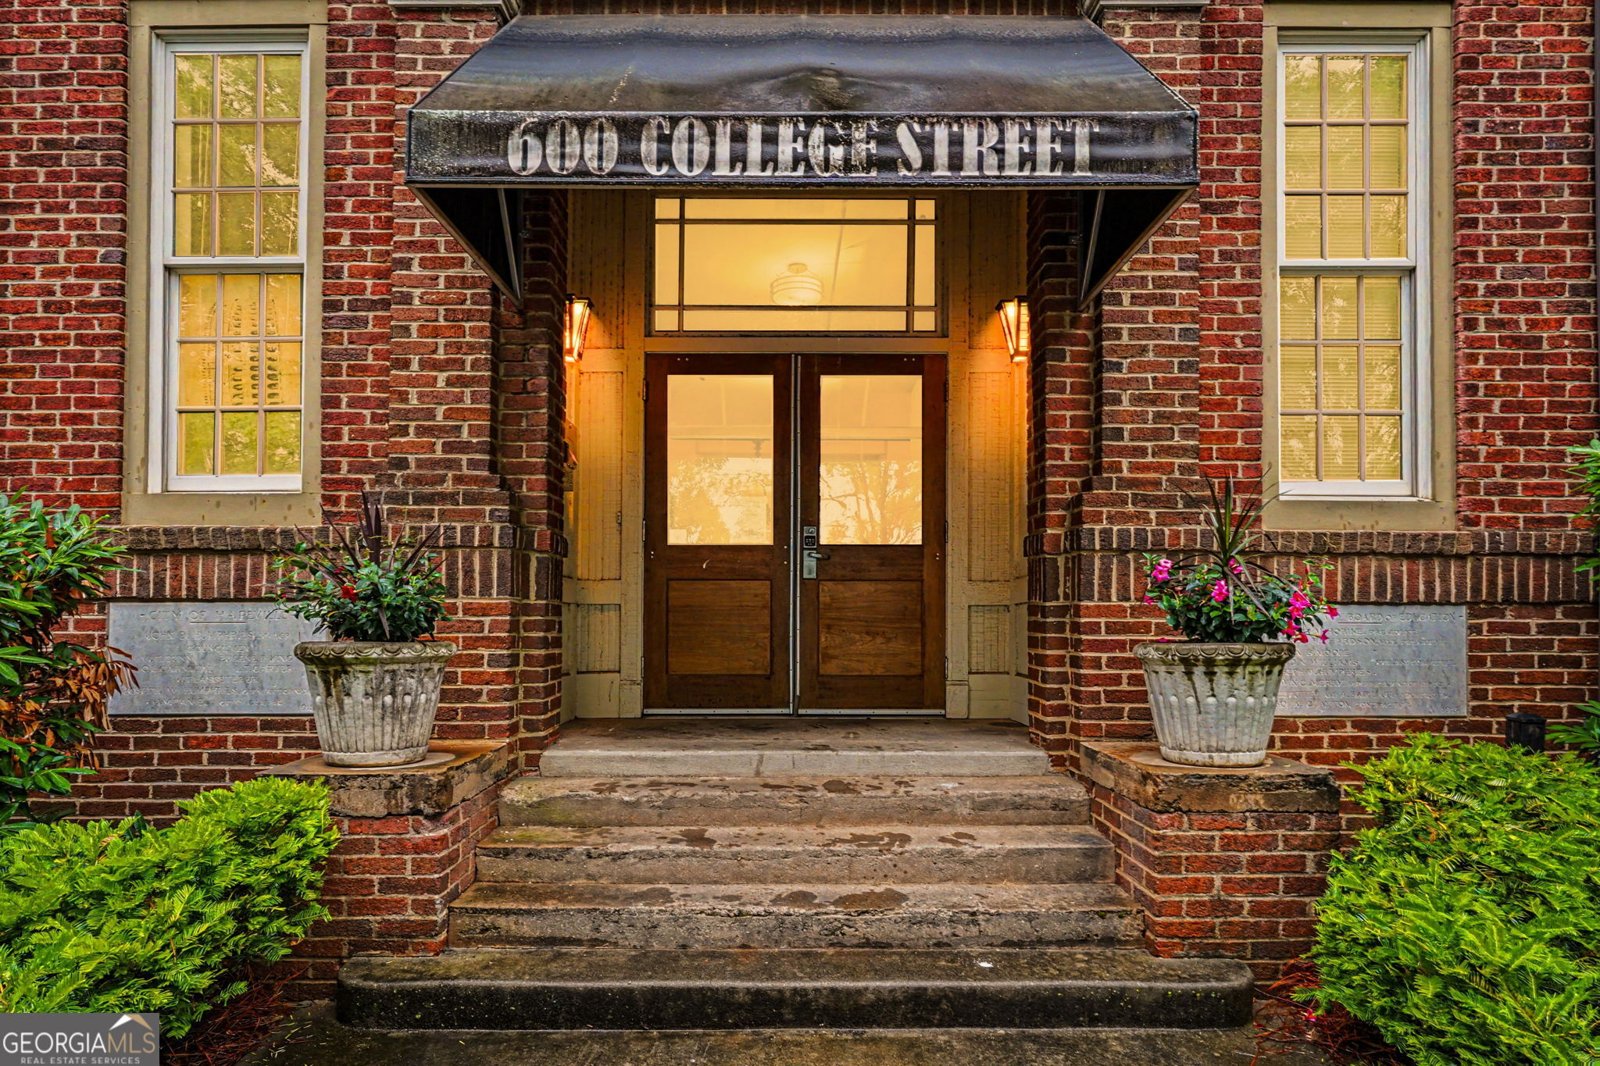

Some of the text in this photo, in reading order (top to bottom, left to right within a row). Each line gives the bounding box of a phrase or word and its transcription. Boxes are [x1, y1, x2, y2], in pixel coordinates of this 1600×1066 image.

[507, 116, 1100, 177] 600 COLLEGE STREET
